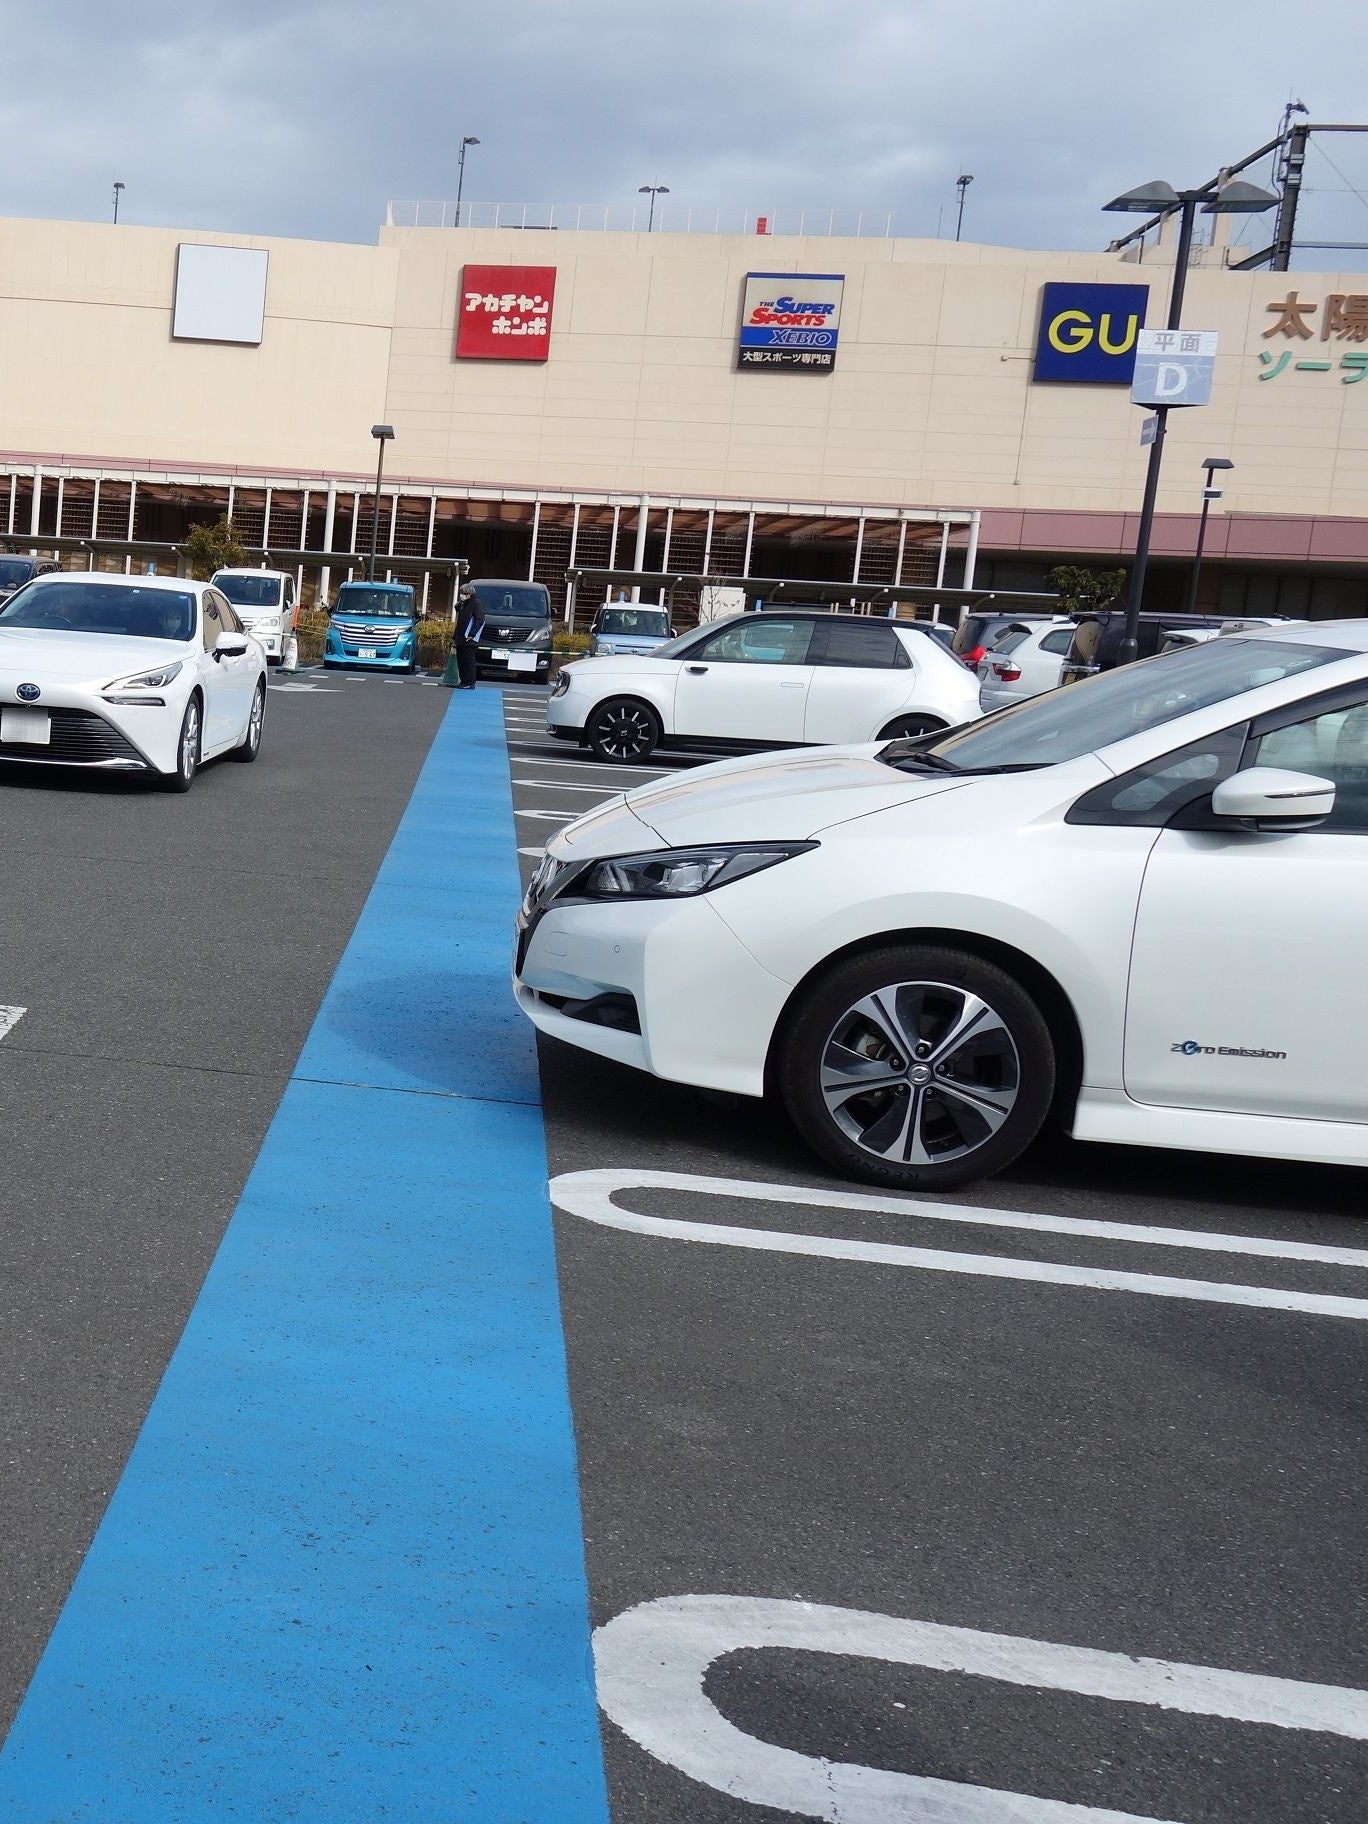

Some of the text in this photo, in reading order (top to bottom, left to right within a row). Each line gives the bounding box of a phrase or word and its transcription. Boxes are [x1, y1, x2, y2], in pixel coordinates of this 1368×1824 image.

[774, 296, 835, 314] SUPER
[492, 315, 547, 335] ホンポ
[749, 307, 827, 326] SPORTS
[1261, 291, 1368, 342] 太陽
[769, 329, 832, 346] XEBIO
[1048, 310, 1138, 355] GU
[1154, 332, 1202, 353] 平面
[743, 351, 832, 365] 大型スポーツ専門店
[1155, 362, 1188, 397] D
[1170, 1040, 1287, 1060] Zero Emission
